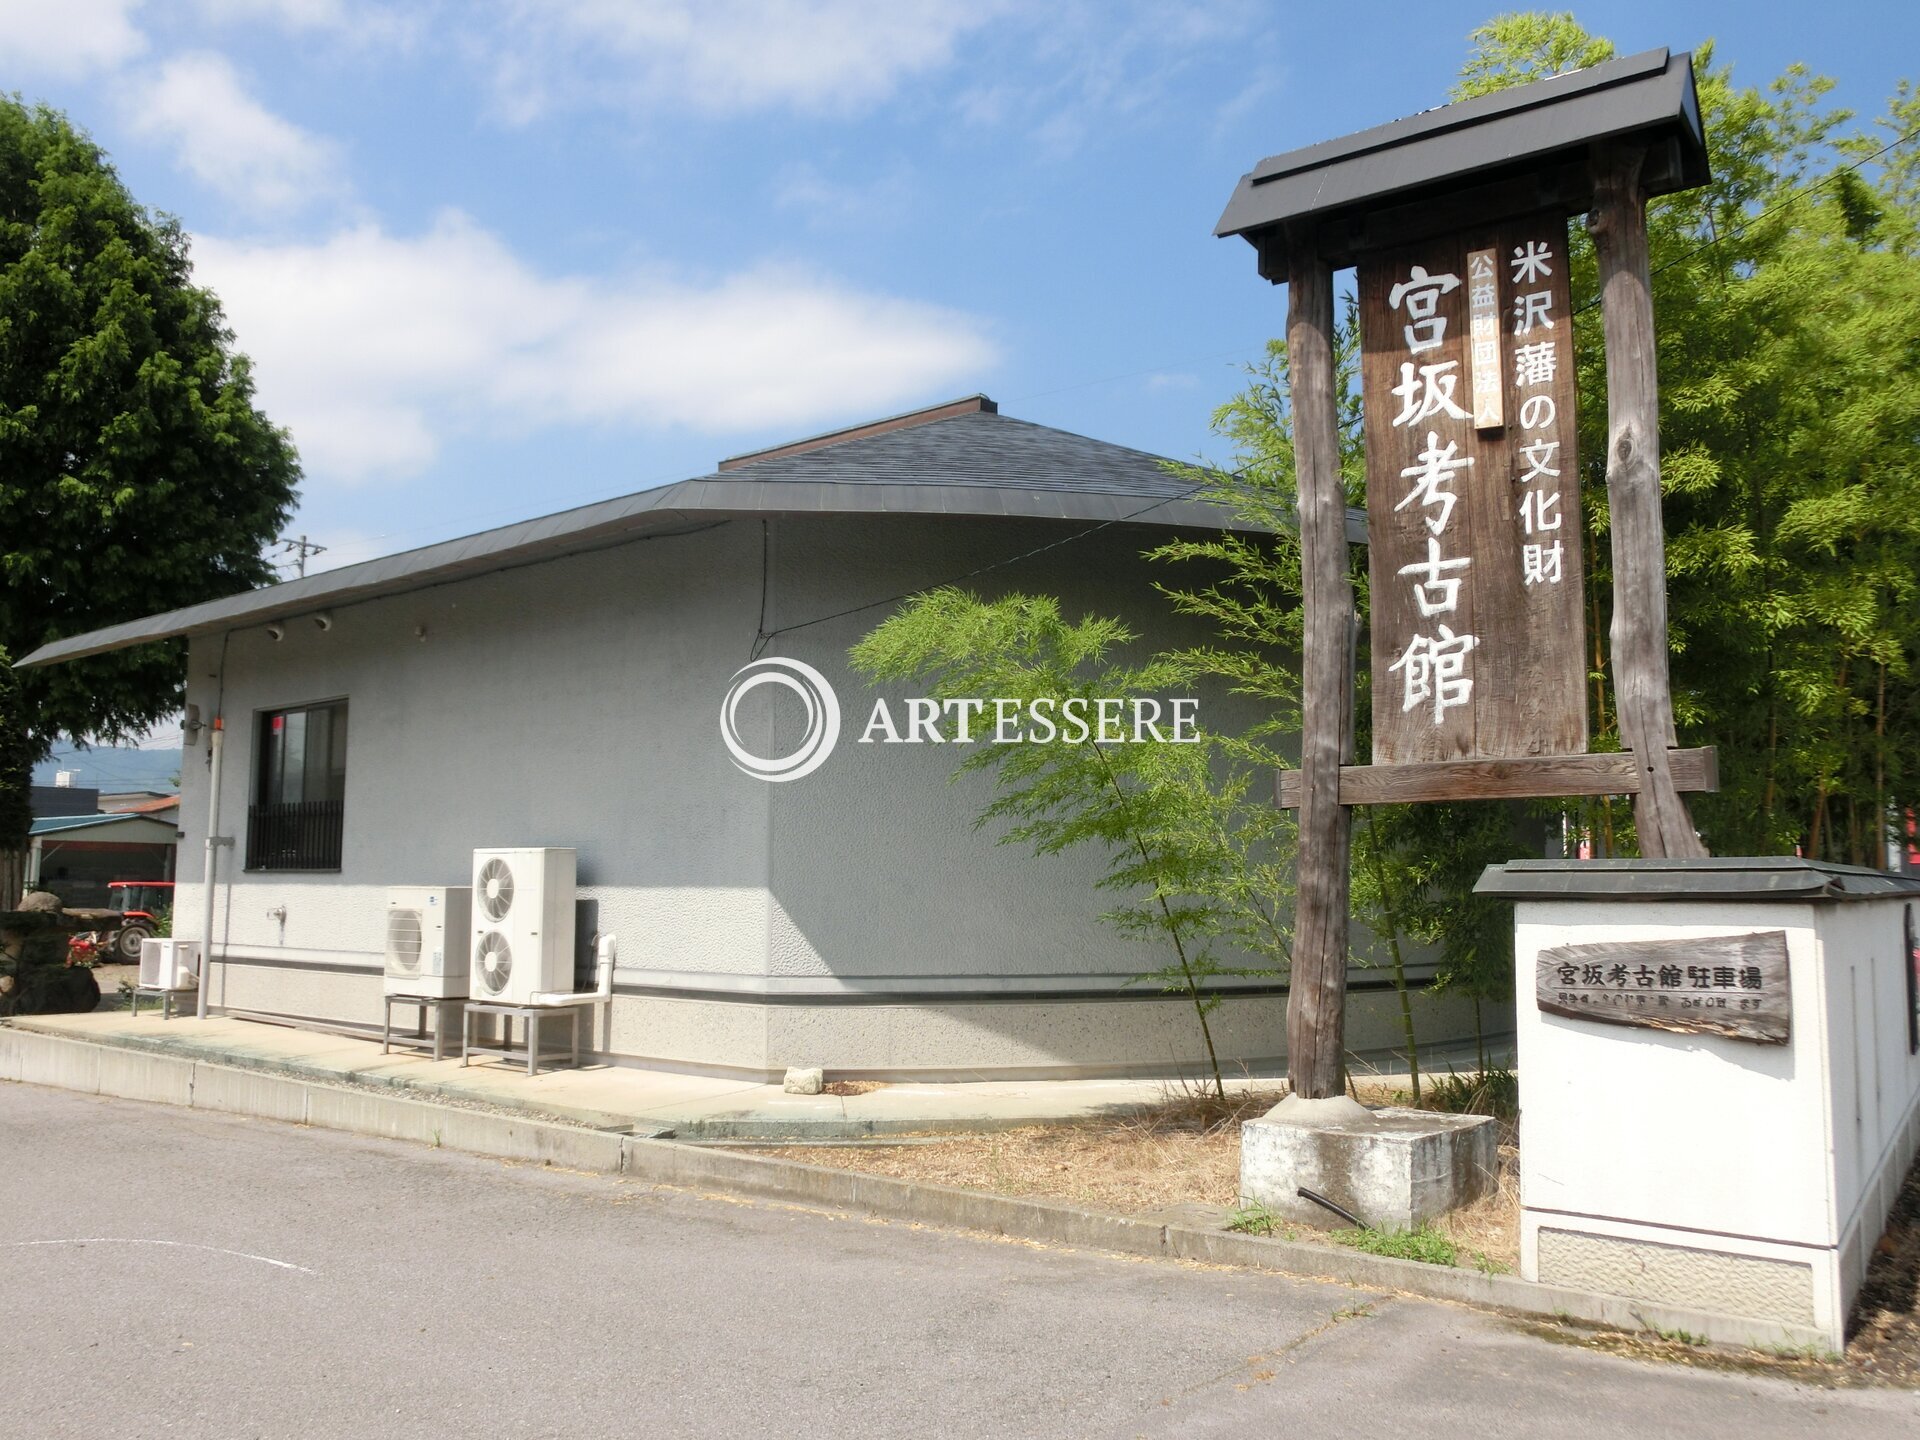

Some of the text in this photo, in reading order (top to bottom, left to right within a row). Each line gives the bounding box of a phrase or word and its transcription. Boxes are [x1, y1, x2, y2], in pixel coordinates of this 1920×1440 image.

[1470, 254, 1500, 424] 公益財団法人
[1510, 240, 1564, 586] 米沢藩の文化財
[1388, 265, 1480, 725] 宮坂考古館
[1557, 962, 1763, 989] 宮坂考古館駐車場
